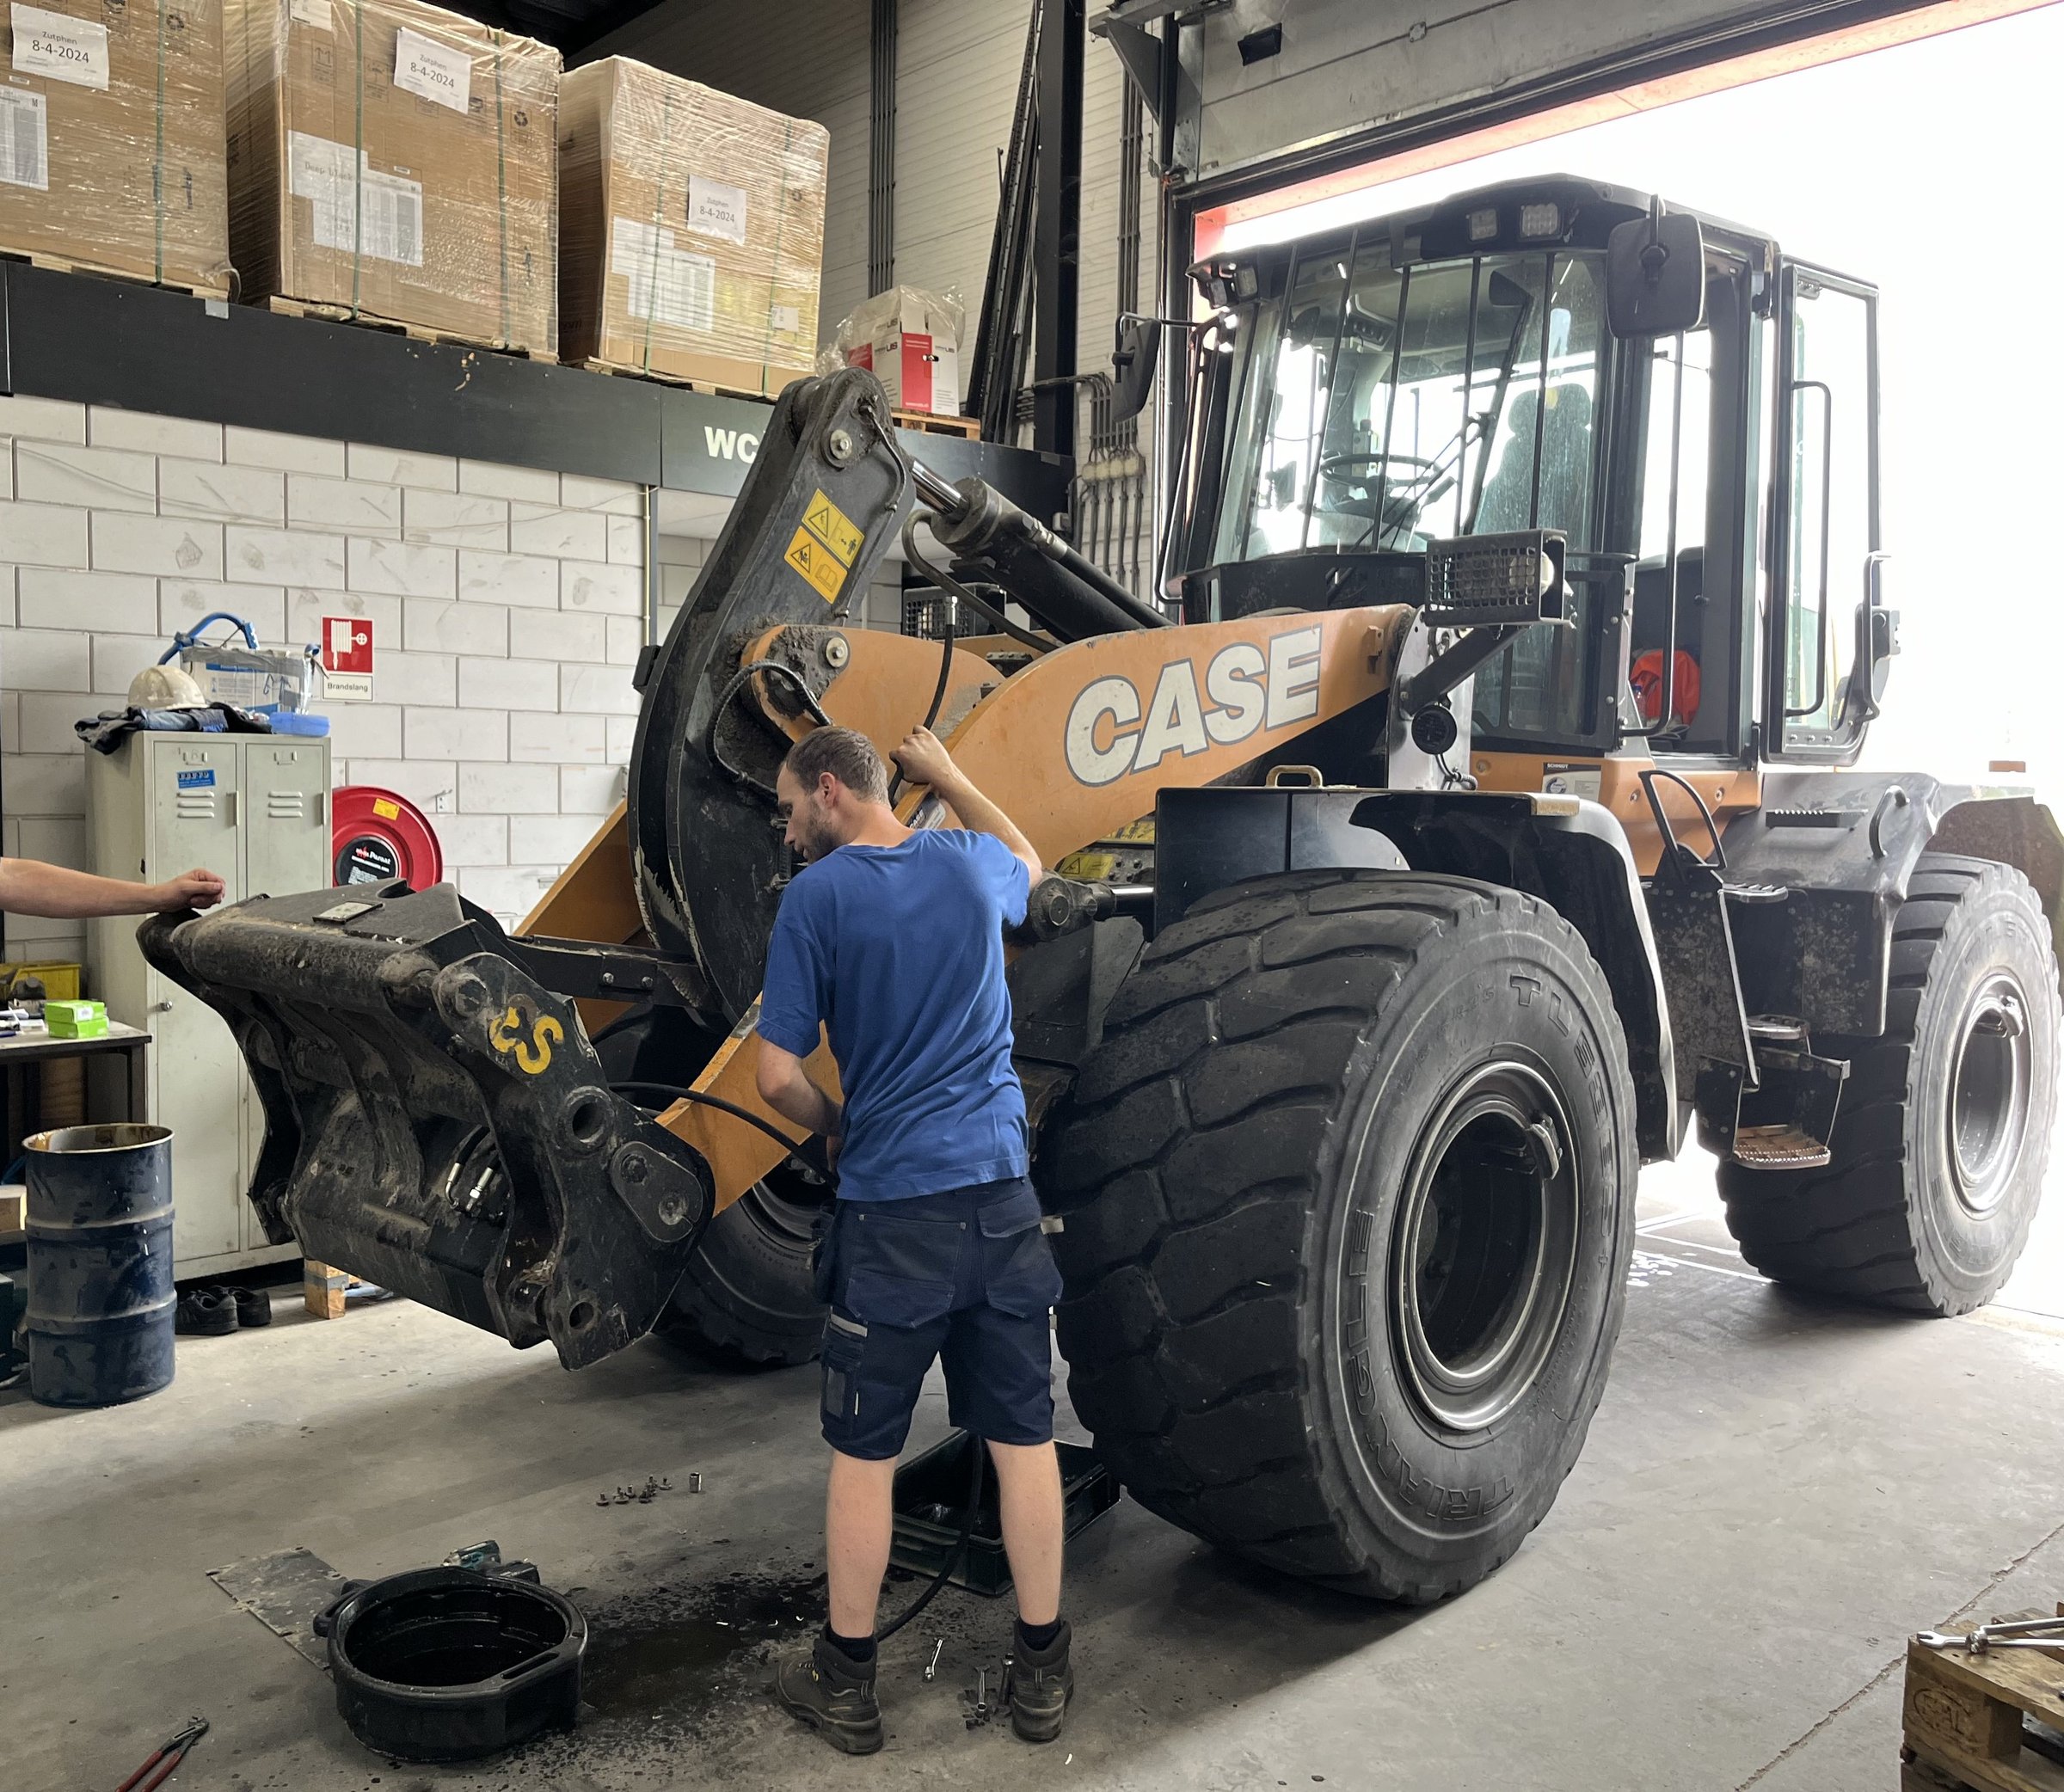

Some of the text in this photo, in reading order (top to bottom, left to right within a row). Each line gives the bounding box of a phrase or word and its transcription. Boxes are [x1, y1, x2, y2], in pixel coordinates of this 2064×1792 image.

[42, 31, 77, 45] Zutphen
[32, 40, 89, 63] 8-4-2024
[420, 53, 447, 71] Zutphen
[410, 62, 454, 88] 8-4-2024
[699, 206, 735, 223] 8-4-2024
[703, 426, 759, 464] WC
[327, 682, 368, 692] Brandslang
[1064, 623, 1323, 788] CASE
[1345, 1208, 1515, 1521] TRIANGLE
